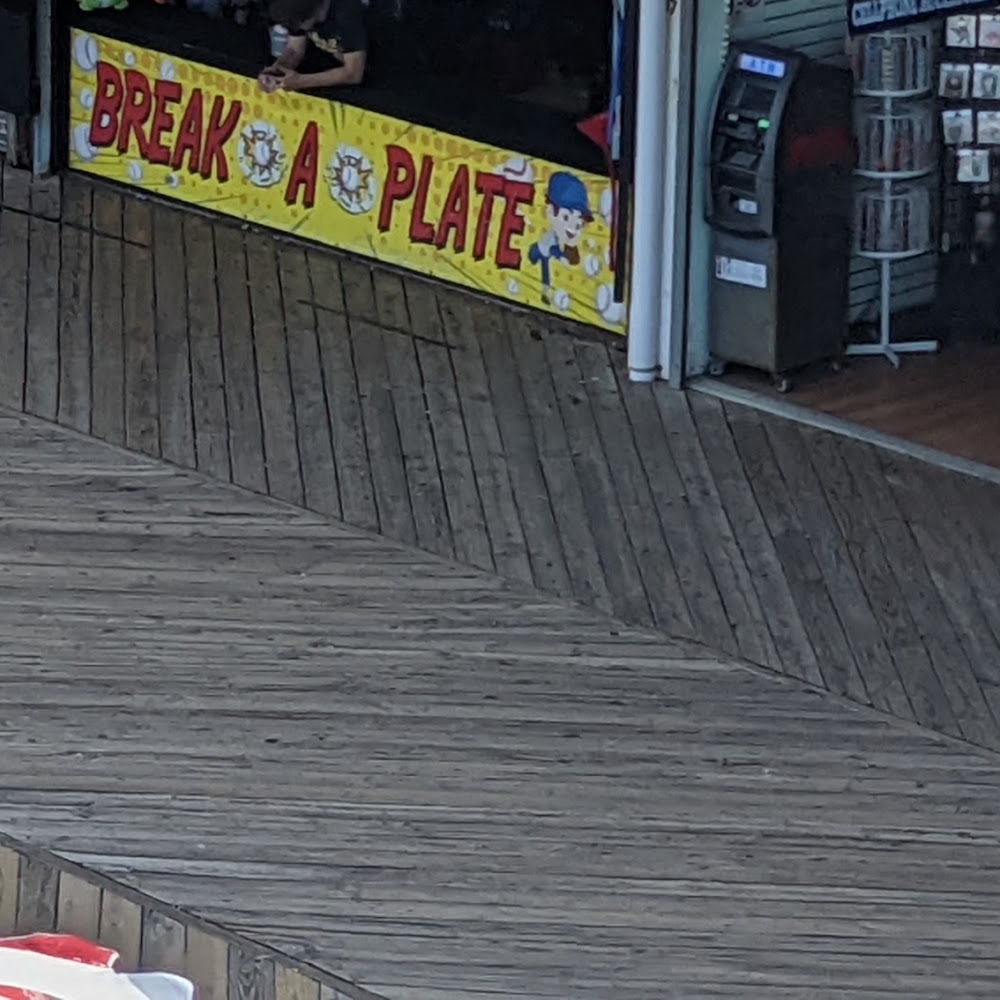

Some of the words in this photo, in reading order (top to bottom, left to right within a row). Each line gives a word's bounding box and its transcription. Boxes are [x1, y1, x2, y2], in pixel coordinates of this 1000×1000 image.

[89, 61, 242, 183] BREAK
[284, 120, 319, 209] A
[377, 144, 535, 271] PLATE
